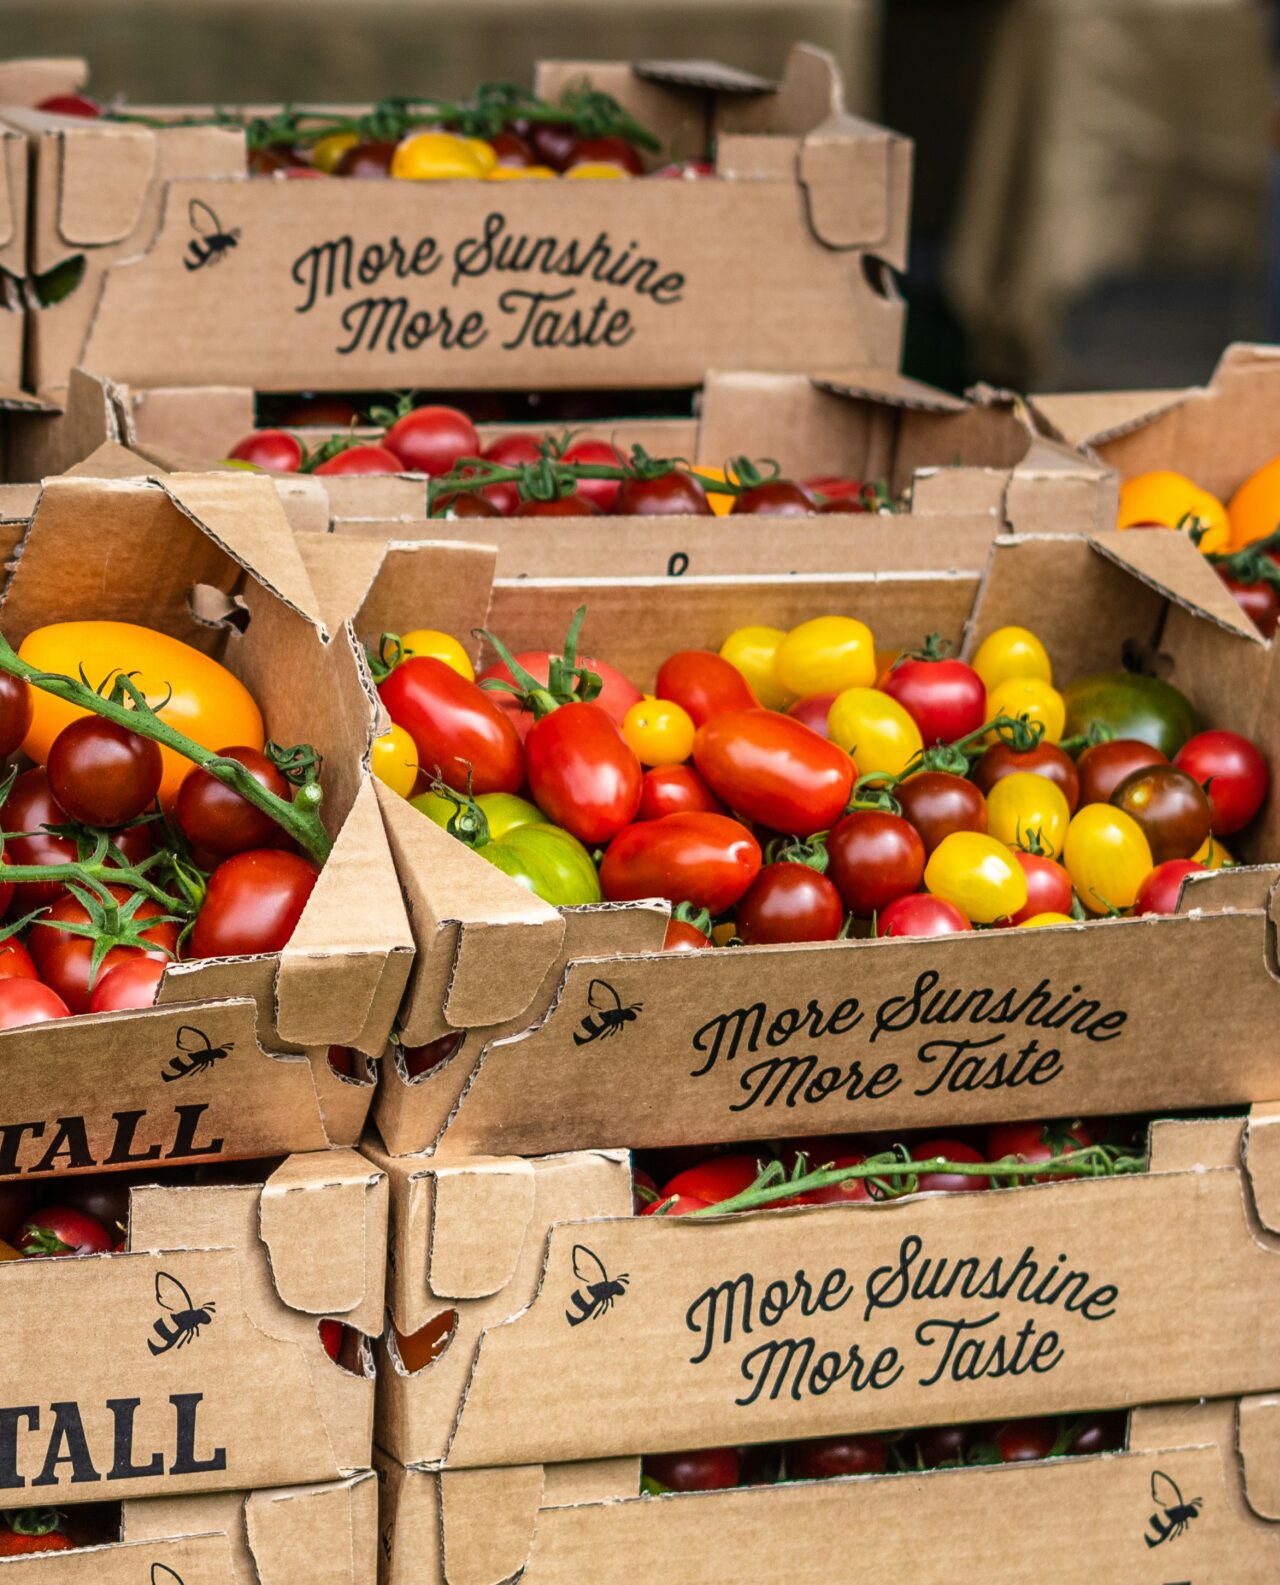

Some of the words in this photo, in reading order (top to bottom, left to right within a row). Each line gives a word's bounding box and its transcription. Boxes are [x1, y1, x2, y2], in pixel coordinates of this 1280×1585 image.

[291, 235, 443, 315] More
[452, 212, 686, 305] Sunshine
[336, 297, 488, 355] More
[498, 288, 635, 350] Taste
[689, 997, 866, 1078] More
[868, 969, 1129, 1044] Sunshine
[728, 1054, 904, 1113] More
[913, 1032, 1065, 1097] Taste
[685, 1268, 854, 1364] More
[863, 1234, 1119, 1322] Sunshine
[734, 1337, 905, 1407] More
[915, 1311, 1065, 1387] Taste
